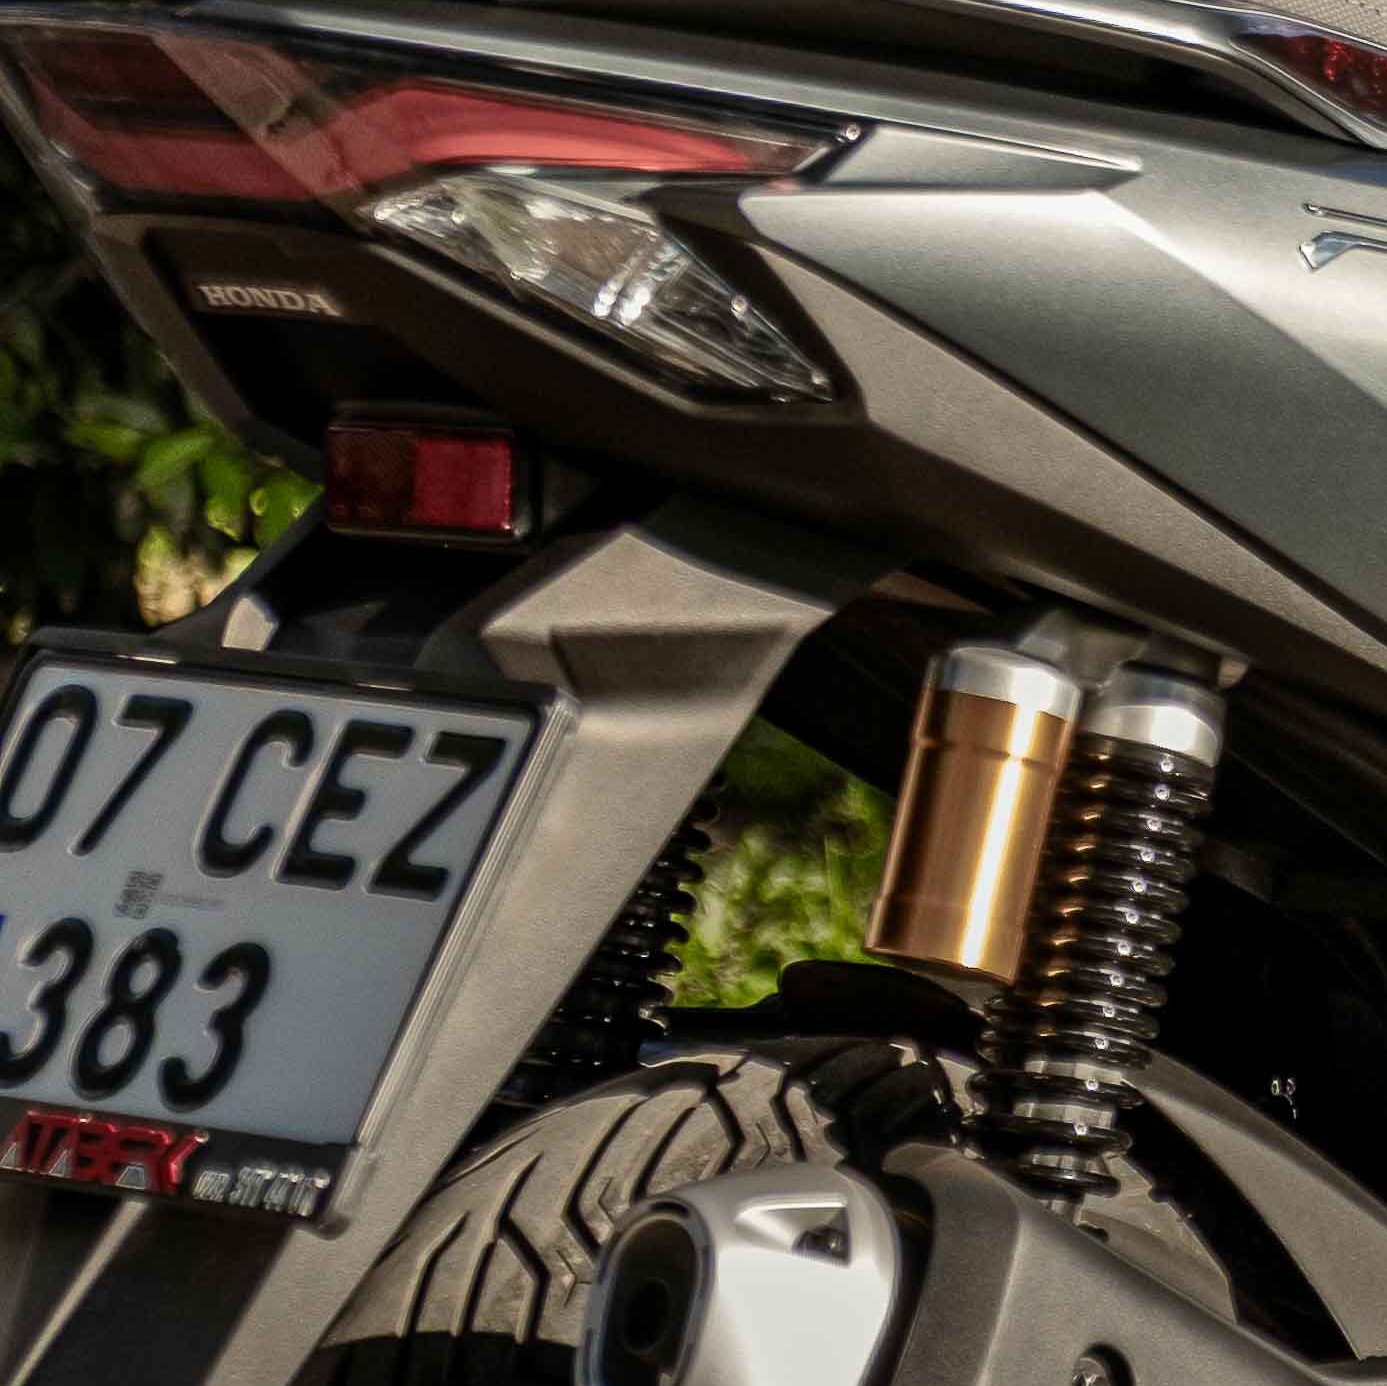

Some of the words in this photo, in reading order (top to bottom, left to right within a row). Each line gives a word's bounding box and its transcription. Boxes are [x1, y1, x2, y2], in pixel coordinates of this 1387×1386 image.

[197, 284, 341, 316] HONDA
[0, 685, 194, 858] 07
[196, 709, 507, 902] CEZ
[0, 917, 272, 1112] 383
